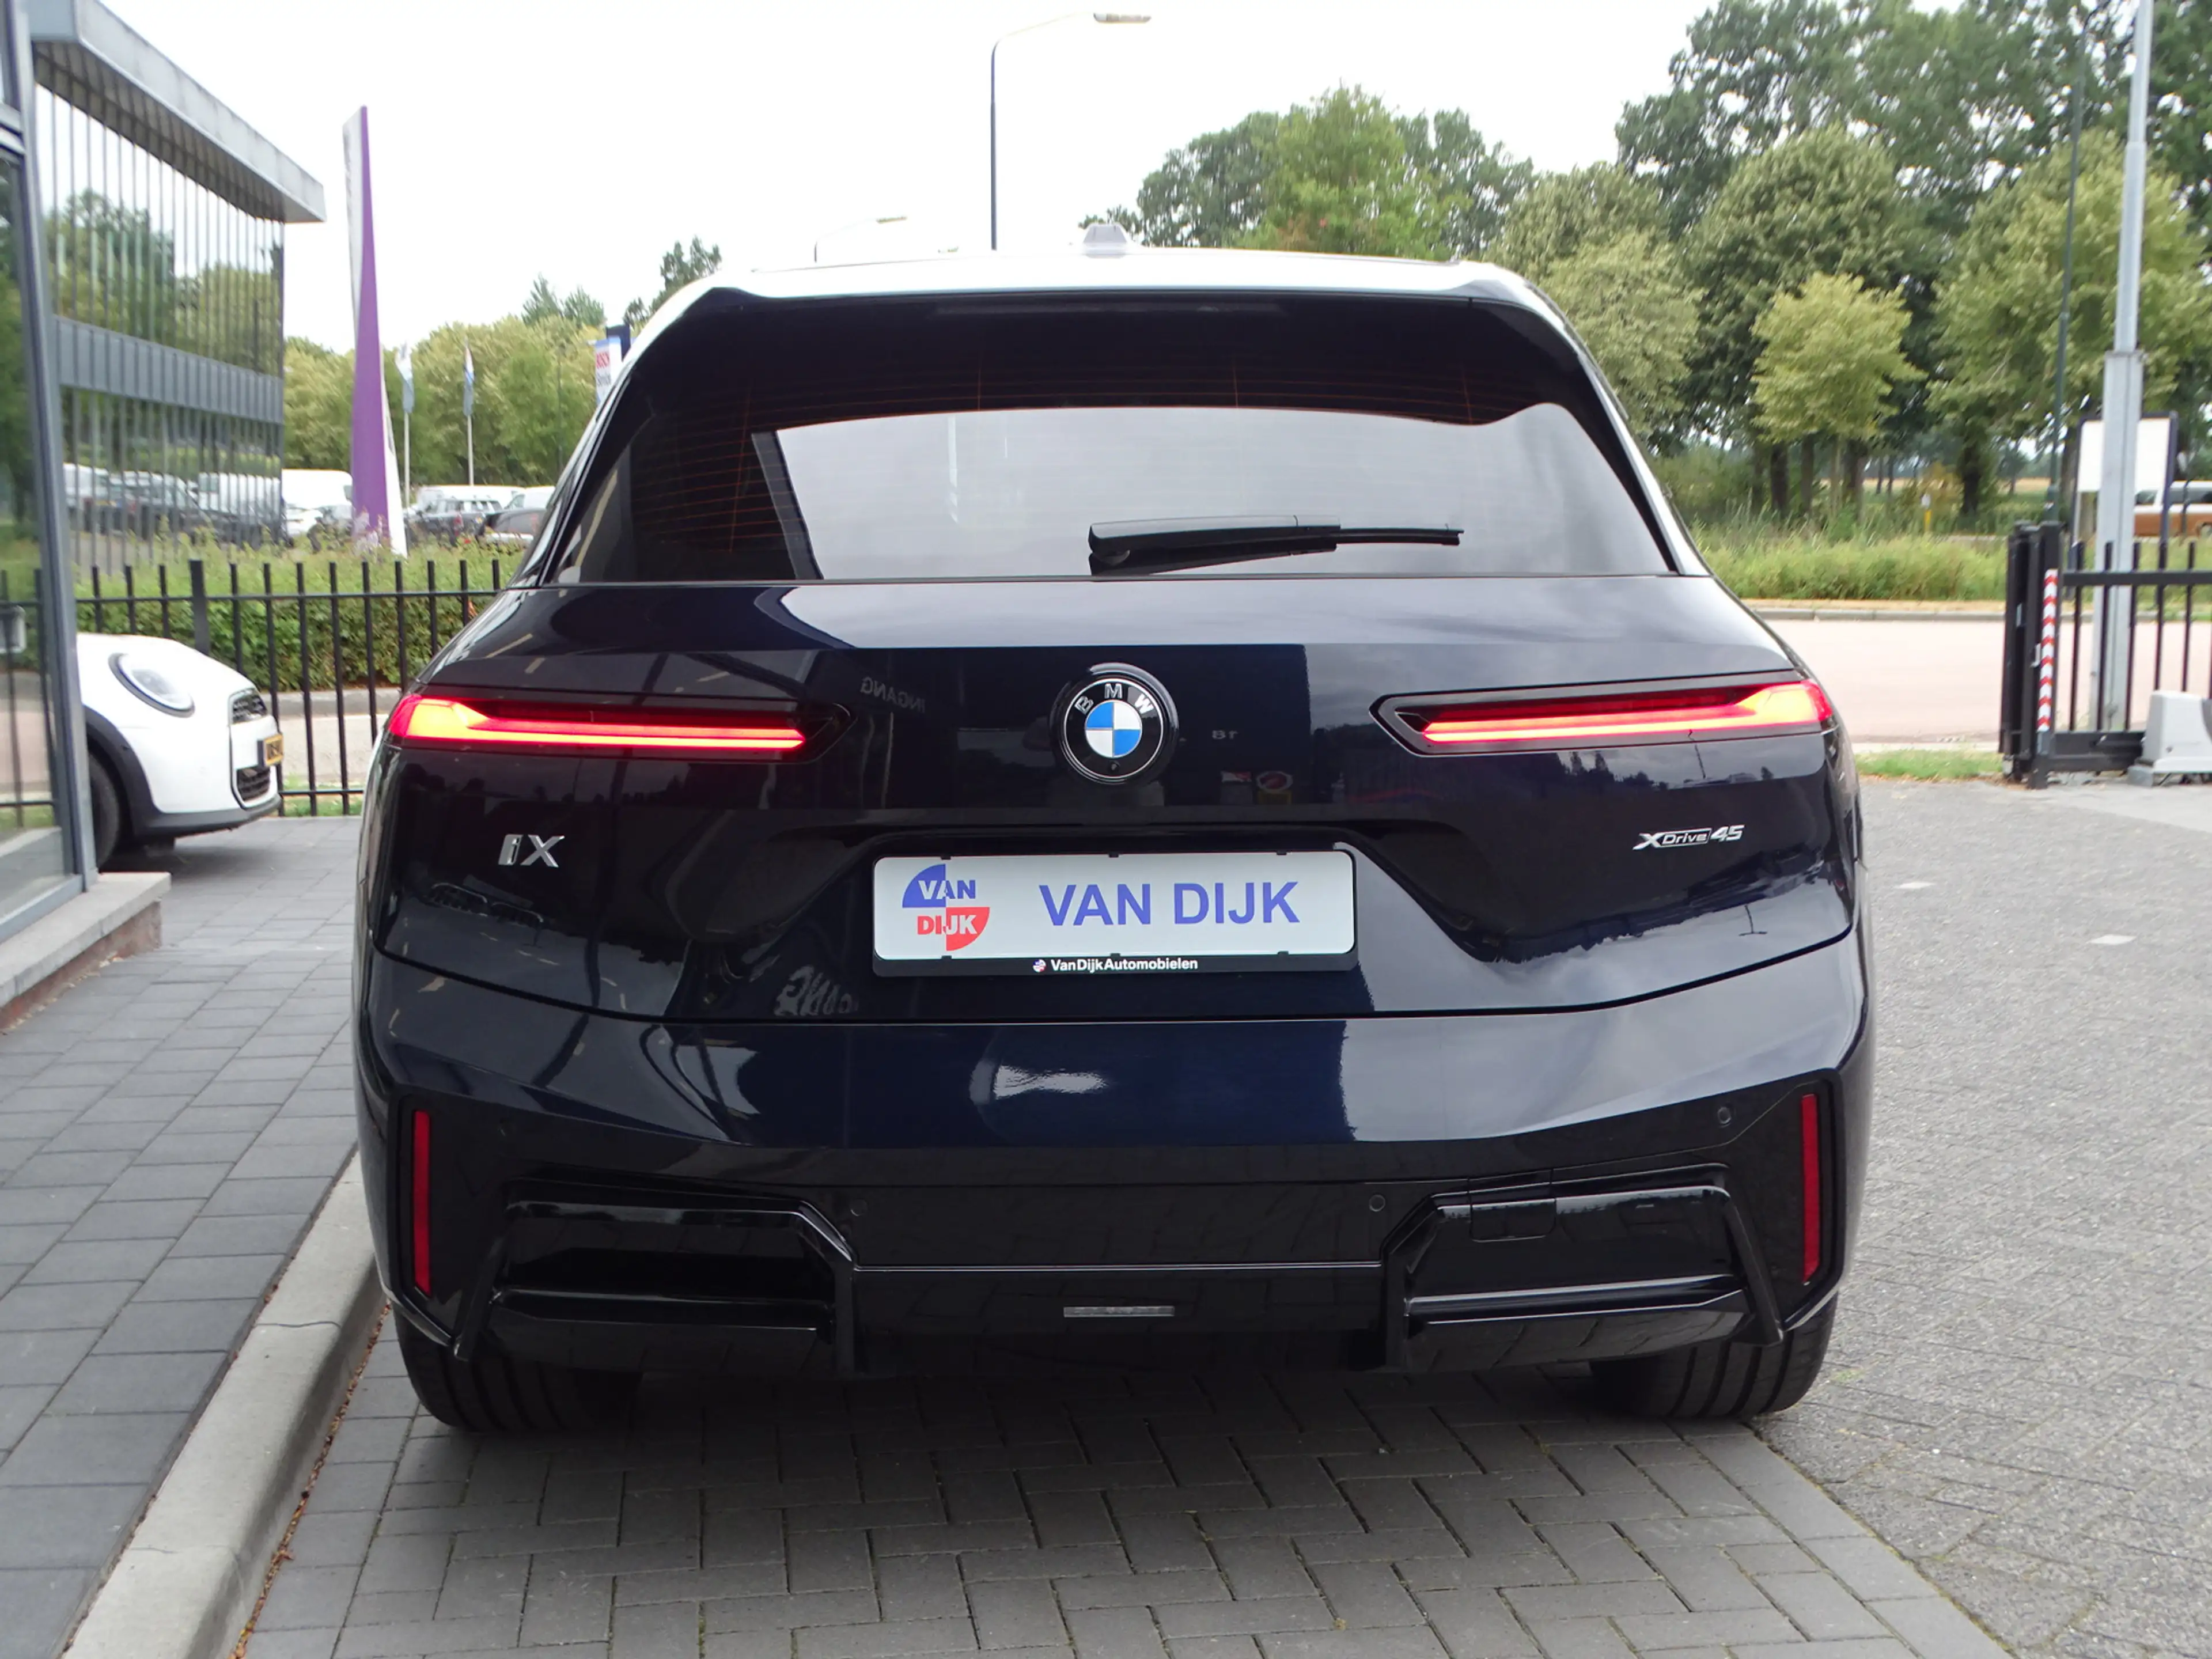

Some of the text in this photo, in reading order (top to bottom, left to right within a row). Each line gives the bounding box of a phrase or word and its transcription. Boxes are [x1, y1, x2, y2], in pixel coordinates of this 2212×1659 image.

[1074, 683, 1153, 715] BMW
[918, 880, 976, 900] VAN
[1038, 881, 1301, 926] VAN DIJK
[917, 915, 978, 935] DIJK
